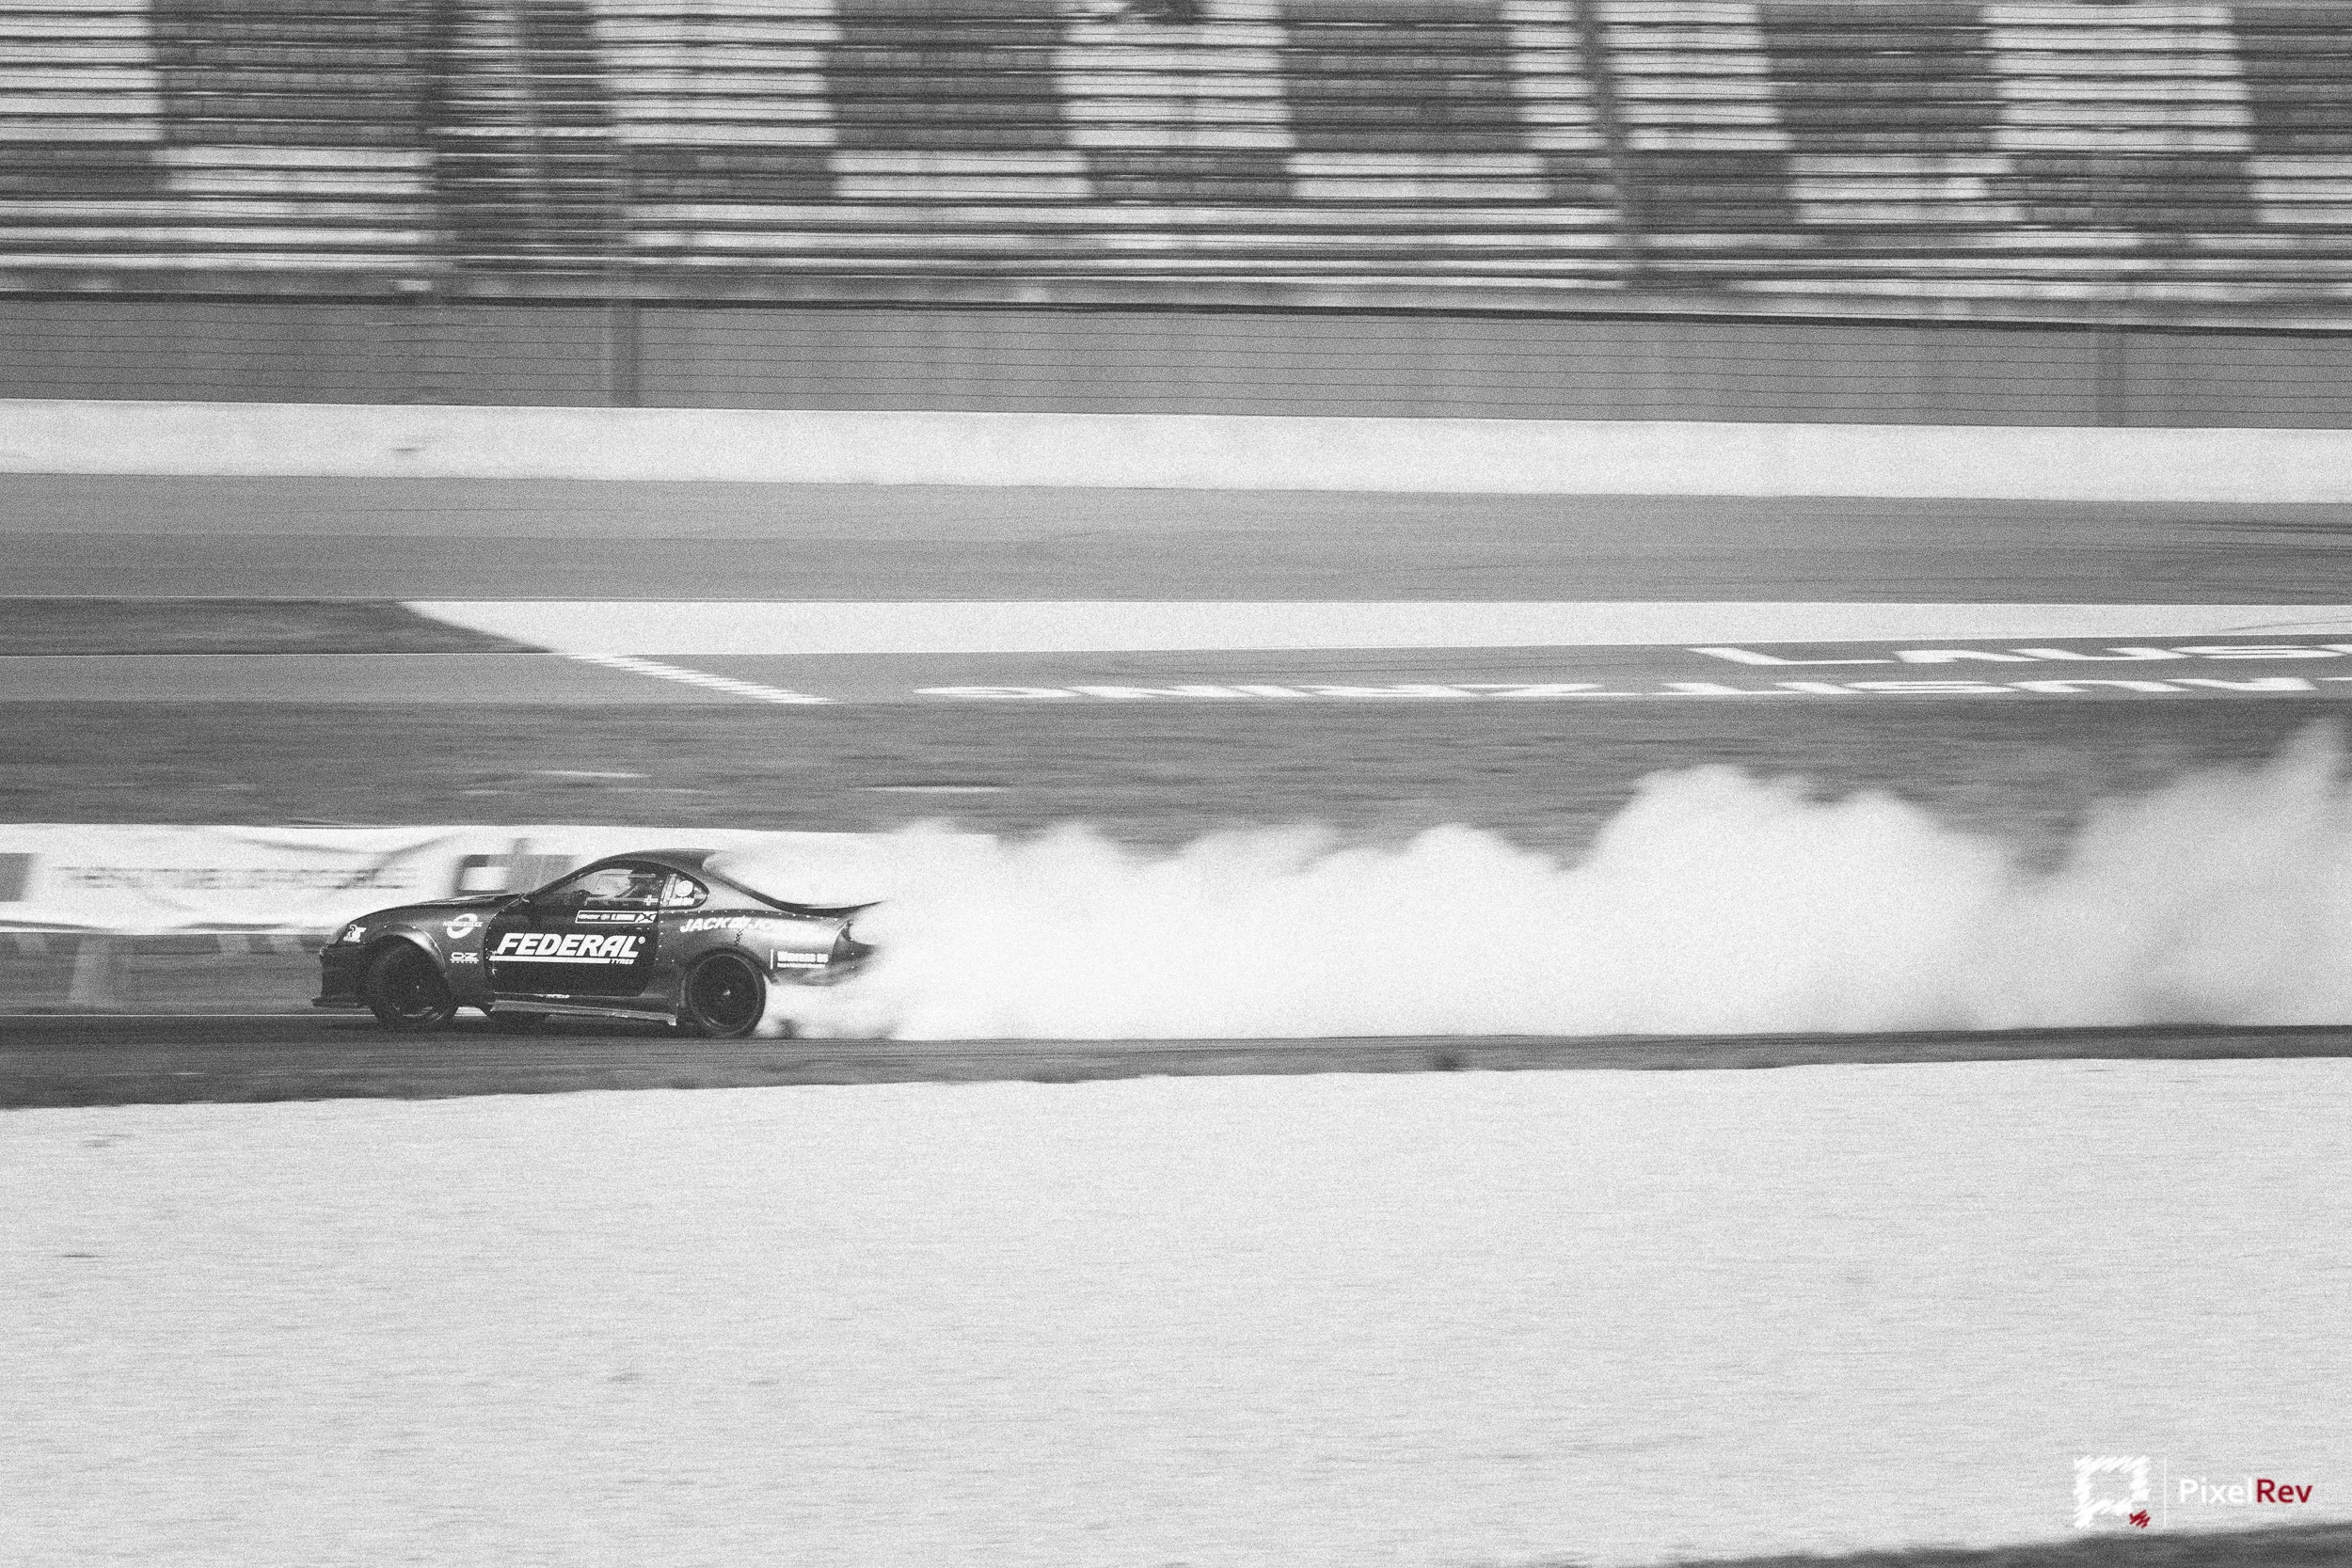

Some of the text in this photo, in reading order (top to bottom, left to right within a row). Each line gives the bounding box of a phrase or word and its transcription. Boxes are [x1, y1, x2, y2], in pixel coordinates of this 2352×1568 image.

[910, 676, 2352, 698] AUSITZRING
[679, 918, 732, 933] JACK
[497, 932, 640, 958] FEDERAL
